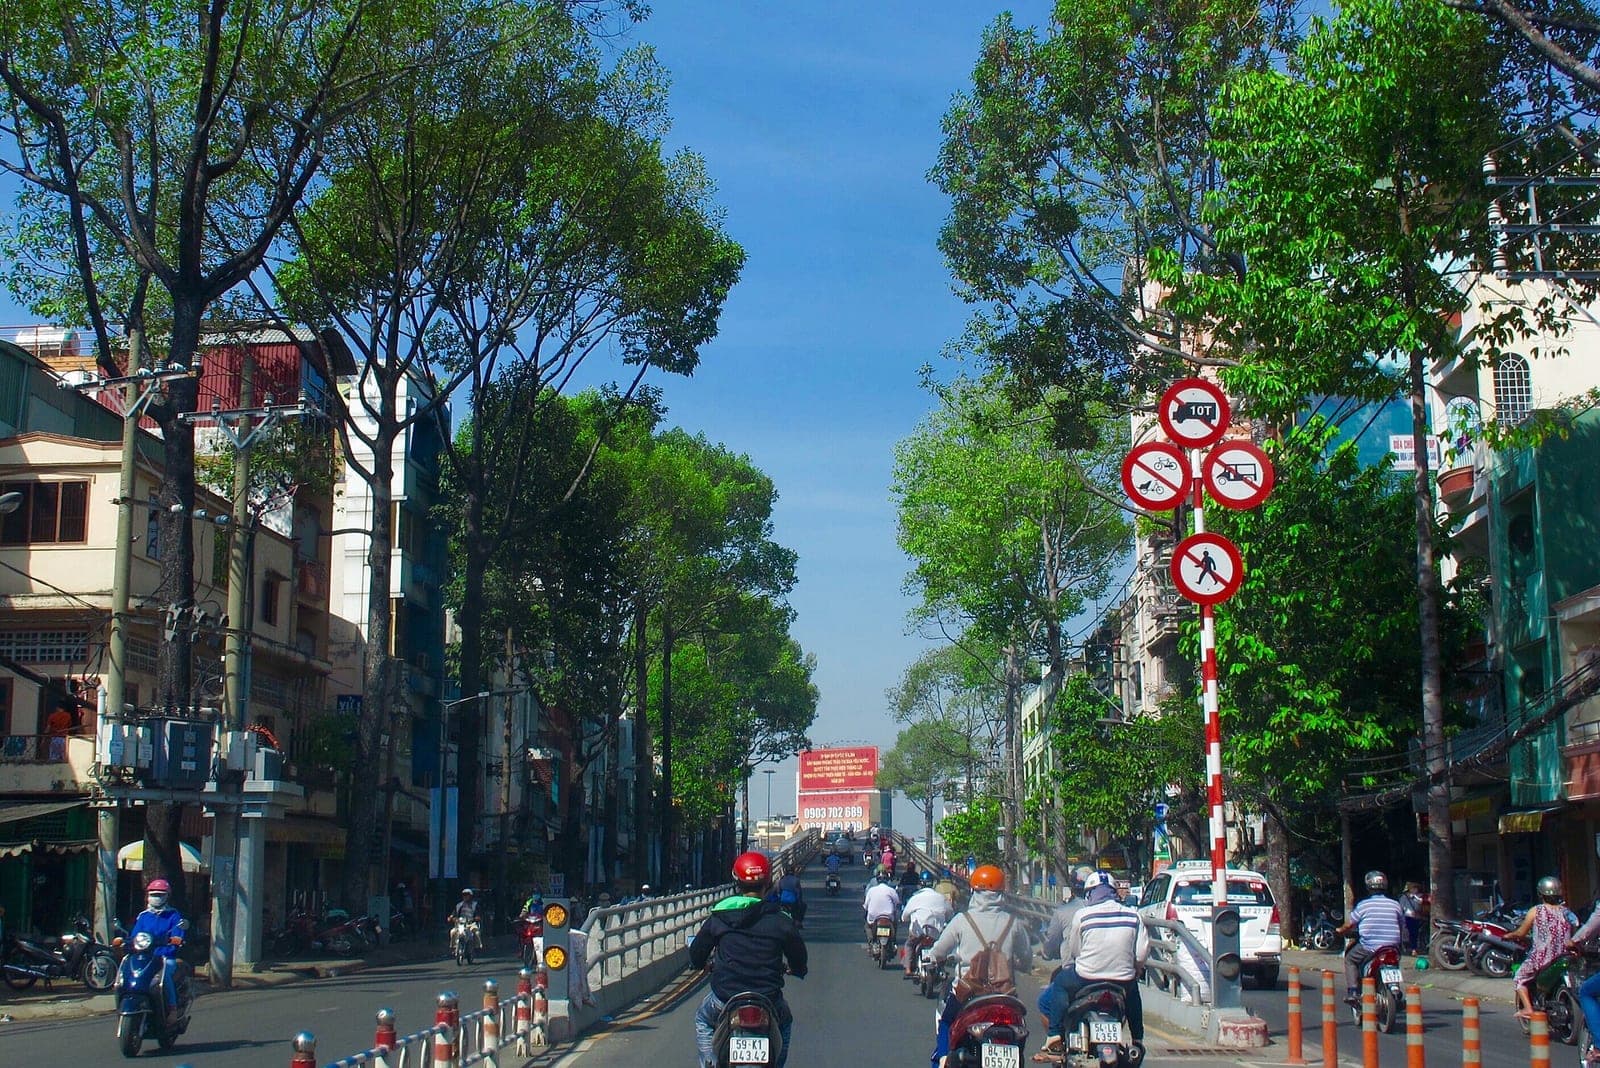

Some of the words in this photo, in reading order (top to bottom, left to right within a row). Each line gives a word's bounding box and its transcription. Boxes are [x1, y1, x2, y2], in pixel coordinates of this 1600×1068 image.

[1190, 406, 1212, 416] 10T
[804, 808, 826, 818] 0903
[828, 807, 843, 818] 702
[845, 806, 863, 818] 689
[1096, 1032, 1118, 1041] 4355
